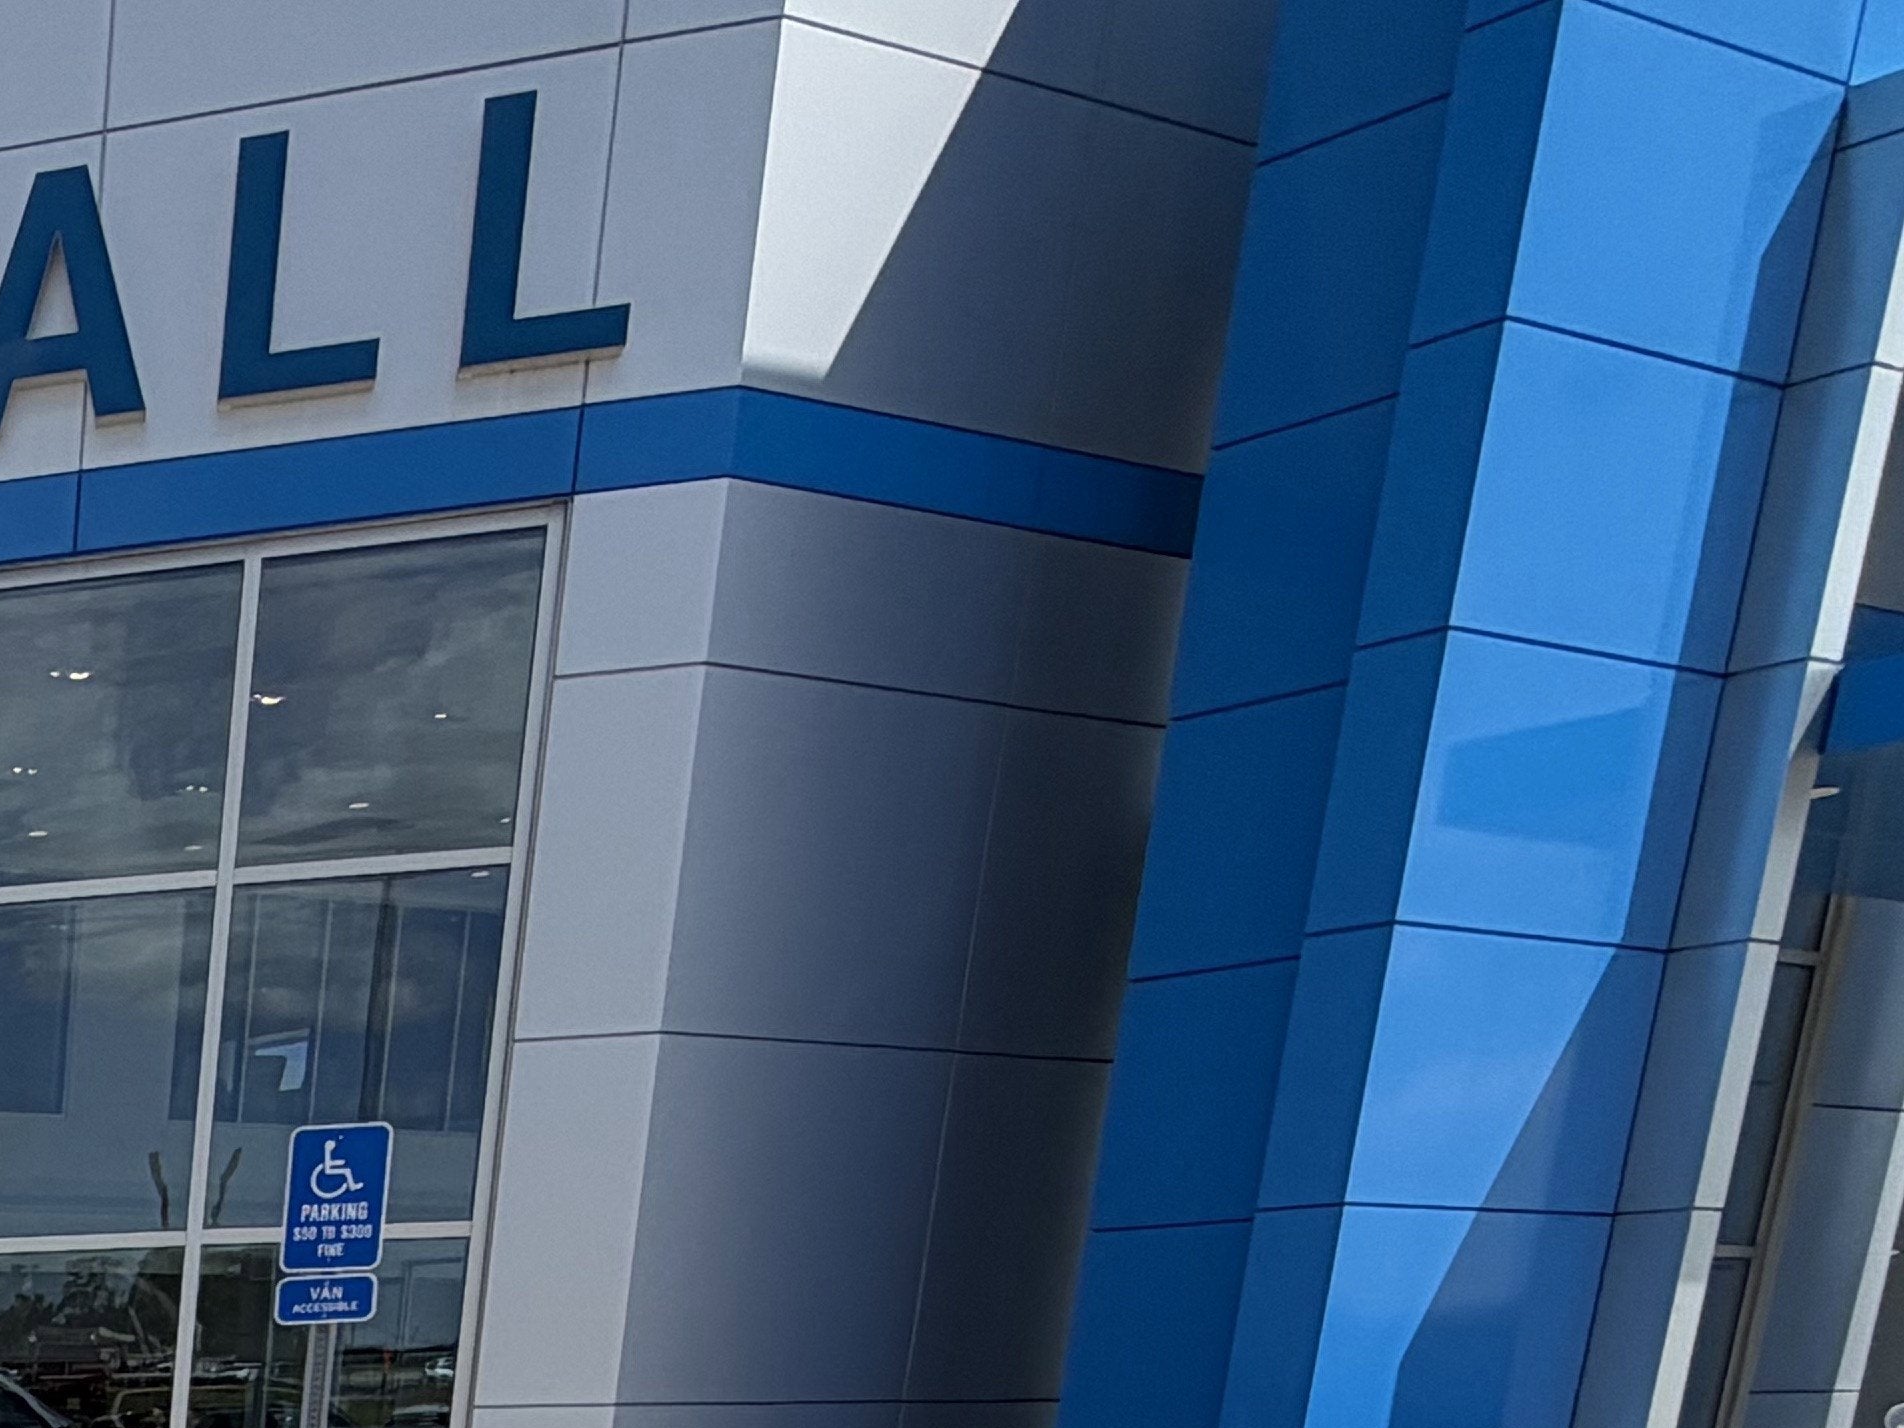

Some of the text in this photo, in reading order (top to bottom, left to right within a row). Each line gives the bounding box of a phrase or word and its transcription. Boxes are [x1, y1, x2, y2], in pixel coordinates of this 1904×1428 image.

[301, 1202, 368, 1221] PARKING
[316, 1242, 345, 1258] FINE
[309, 1286, 344, 1301] VAN
[293, 1301, 359, 1313] ACCESSIBLE
